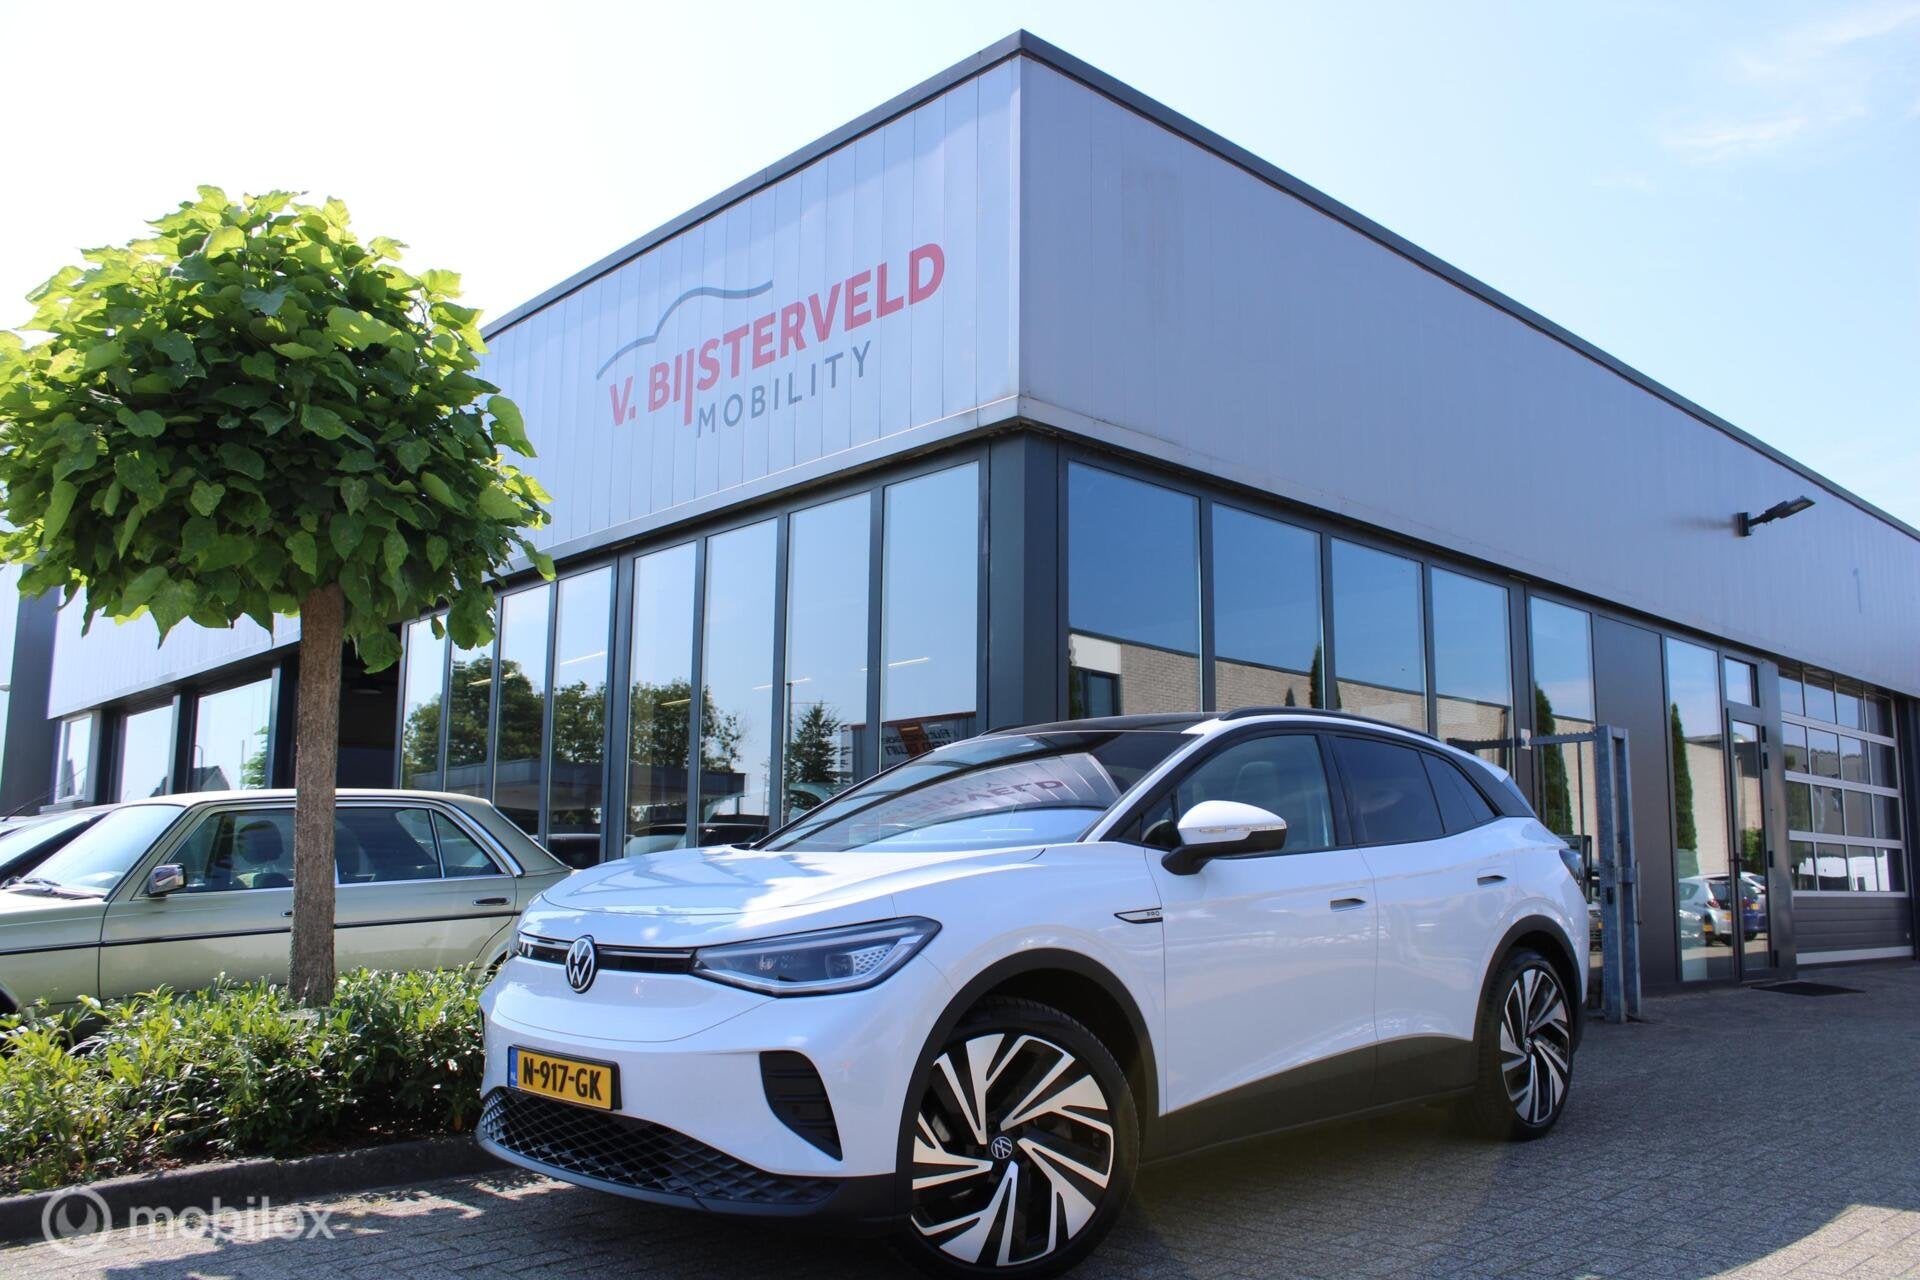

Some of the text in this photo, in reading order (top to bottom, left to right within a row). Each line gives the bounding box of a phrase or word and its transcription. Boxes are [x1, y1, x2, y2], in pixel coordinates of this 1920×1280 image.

[609, 376, 636, 427] V.
[697, 340, 872, 439] MOBILITY
[522, 1056, 603, 1101] N-917-GK
